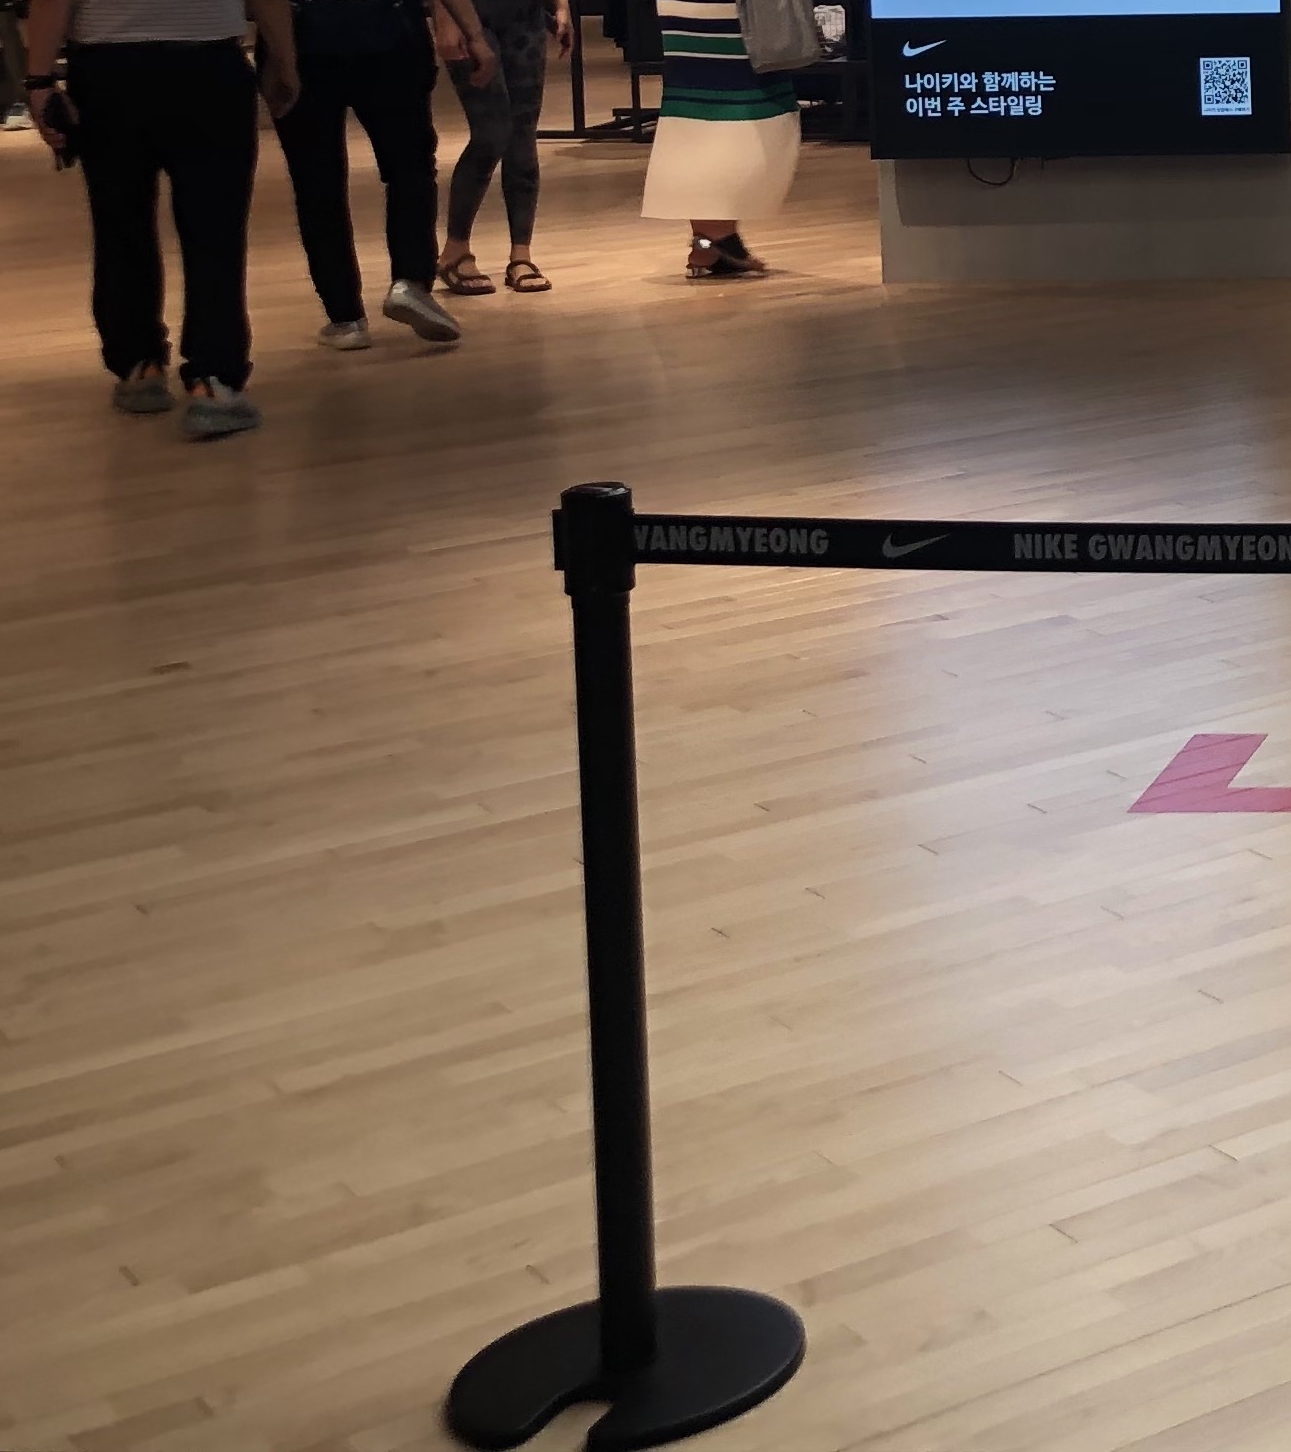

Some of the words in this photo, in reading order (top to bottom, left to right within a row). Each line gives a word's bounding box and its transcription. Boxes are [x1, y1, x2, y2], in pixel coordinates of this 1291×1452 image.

[905, 72, 978, 93] 나이키와
[982, 71, 1056, 93] 함께하는
[906, 97, 942, 117] 이번
[946, 97, 965, 116] 주
[970, 95, 1043, 116] 스타일링
[1014, 533, 1078, 560] NIKE
